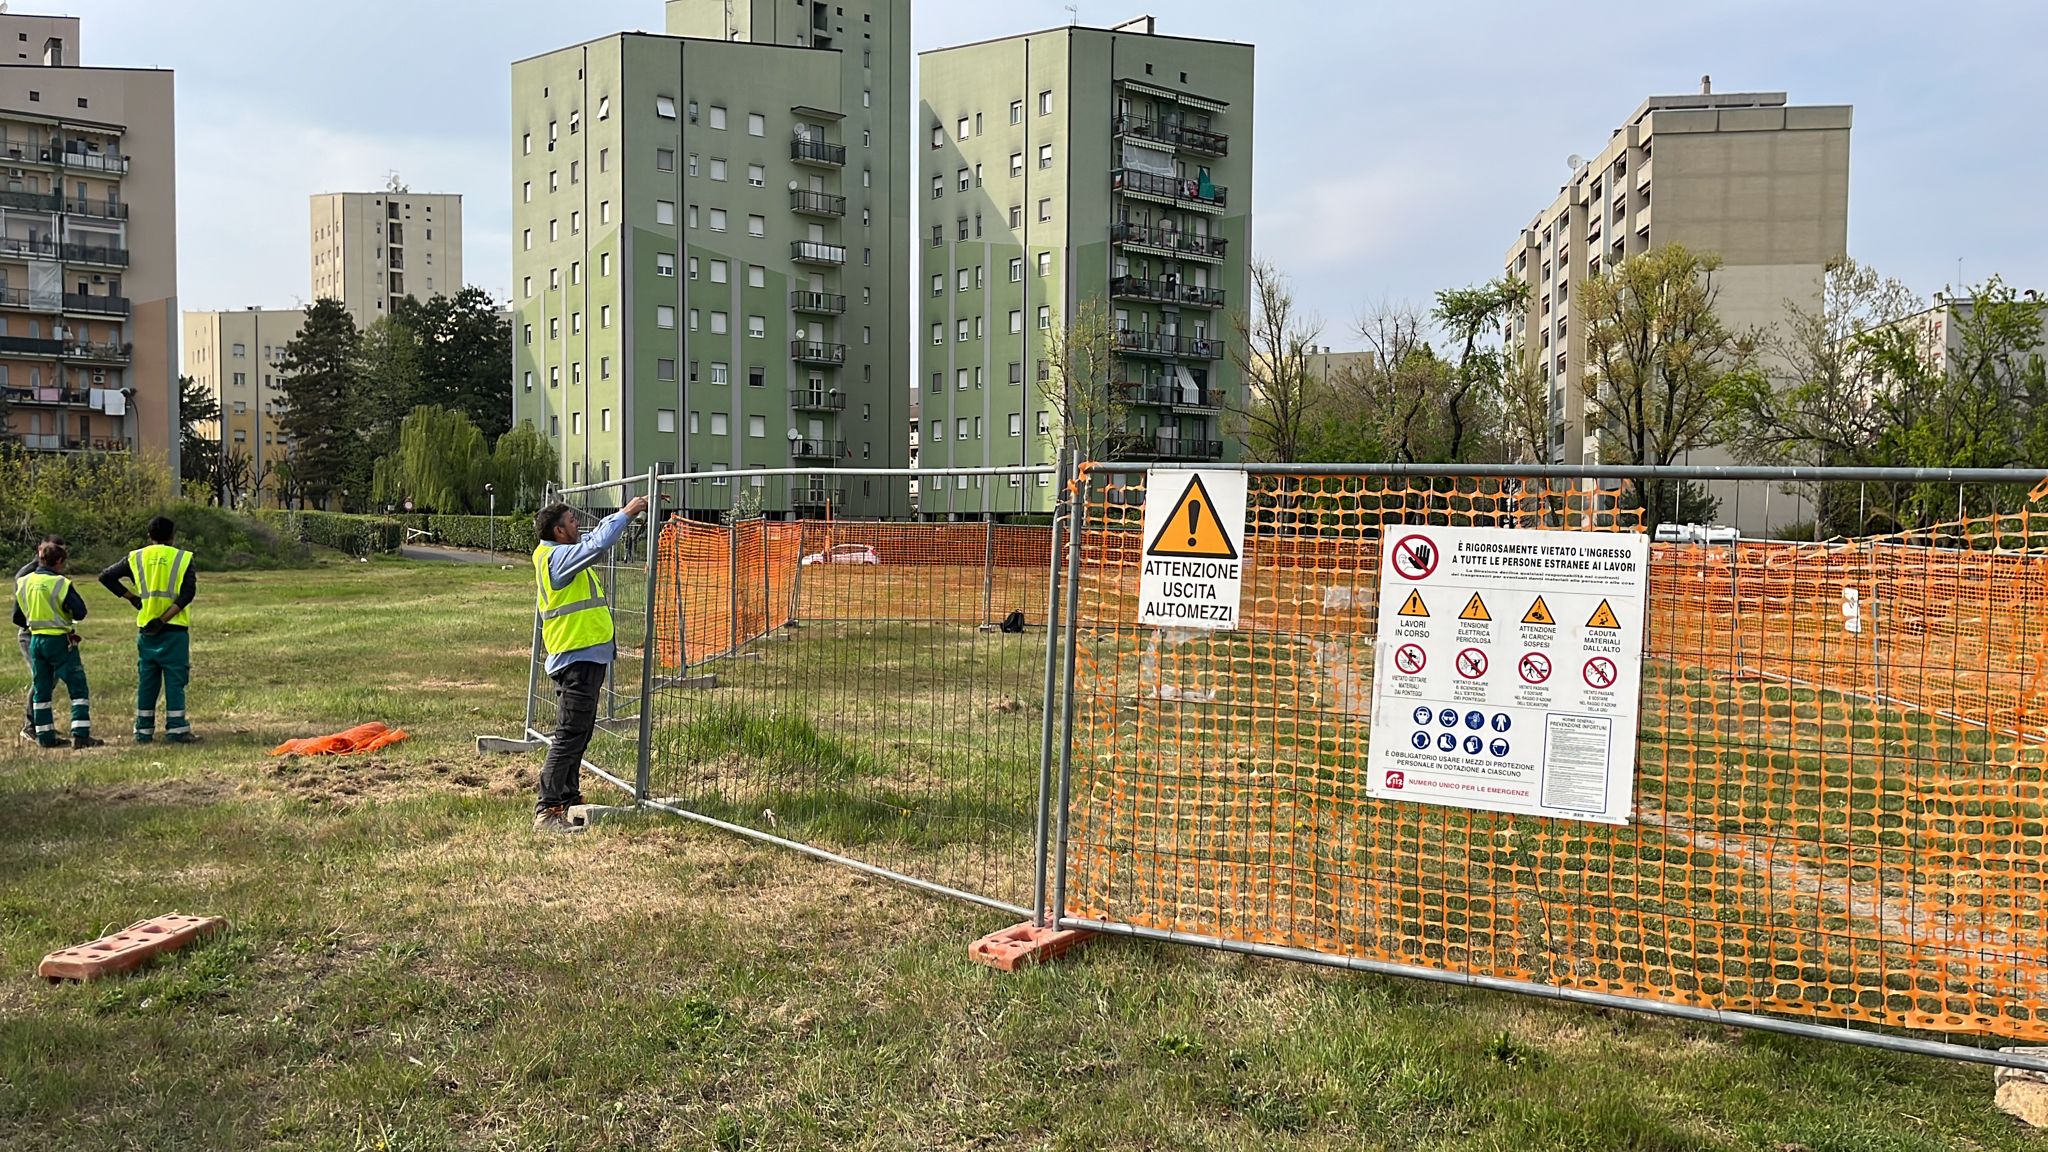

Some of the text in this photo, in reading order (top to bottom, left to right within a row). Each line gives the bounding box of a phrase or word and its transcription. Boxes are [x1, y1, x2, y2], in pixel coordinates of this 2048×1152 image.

[1458, 540, 1631, 558] È RIGOROSAMENTE VIETATO L'INGRESSO
[1145, 561, 1238, 579] ATTENZIONE
[1452, 555, 1635, 572] A TUTTE LE PERSONE ESTRANEE AI LAVORI
[1163, 582, 1216, 599] USCITA
[1145, 602, 1231, 621] AUTOMEZZI
[1400, 620, 1426, 628] LAVORI
[1404, 630, 1430, 638] CORSO
[1583, 645, 1620, 653] DALL'ALTO
[1391, 751, 1437, 760] OBBLIGATORIO
[1494, 762, 1534, 770] PROTEZIONE
[1397, 760, 1434, 768] PERSONALE
[1444, 764, 1479, 773] DOTAZIONE
[1487, 769, 1521, 777] CIASCUNO
[1487, 787, 1529, 796] EMERGENZE
